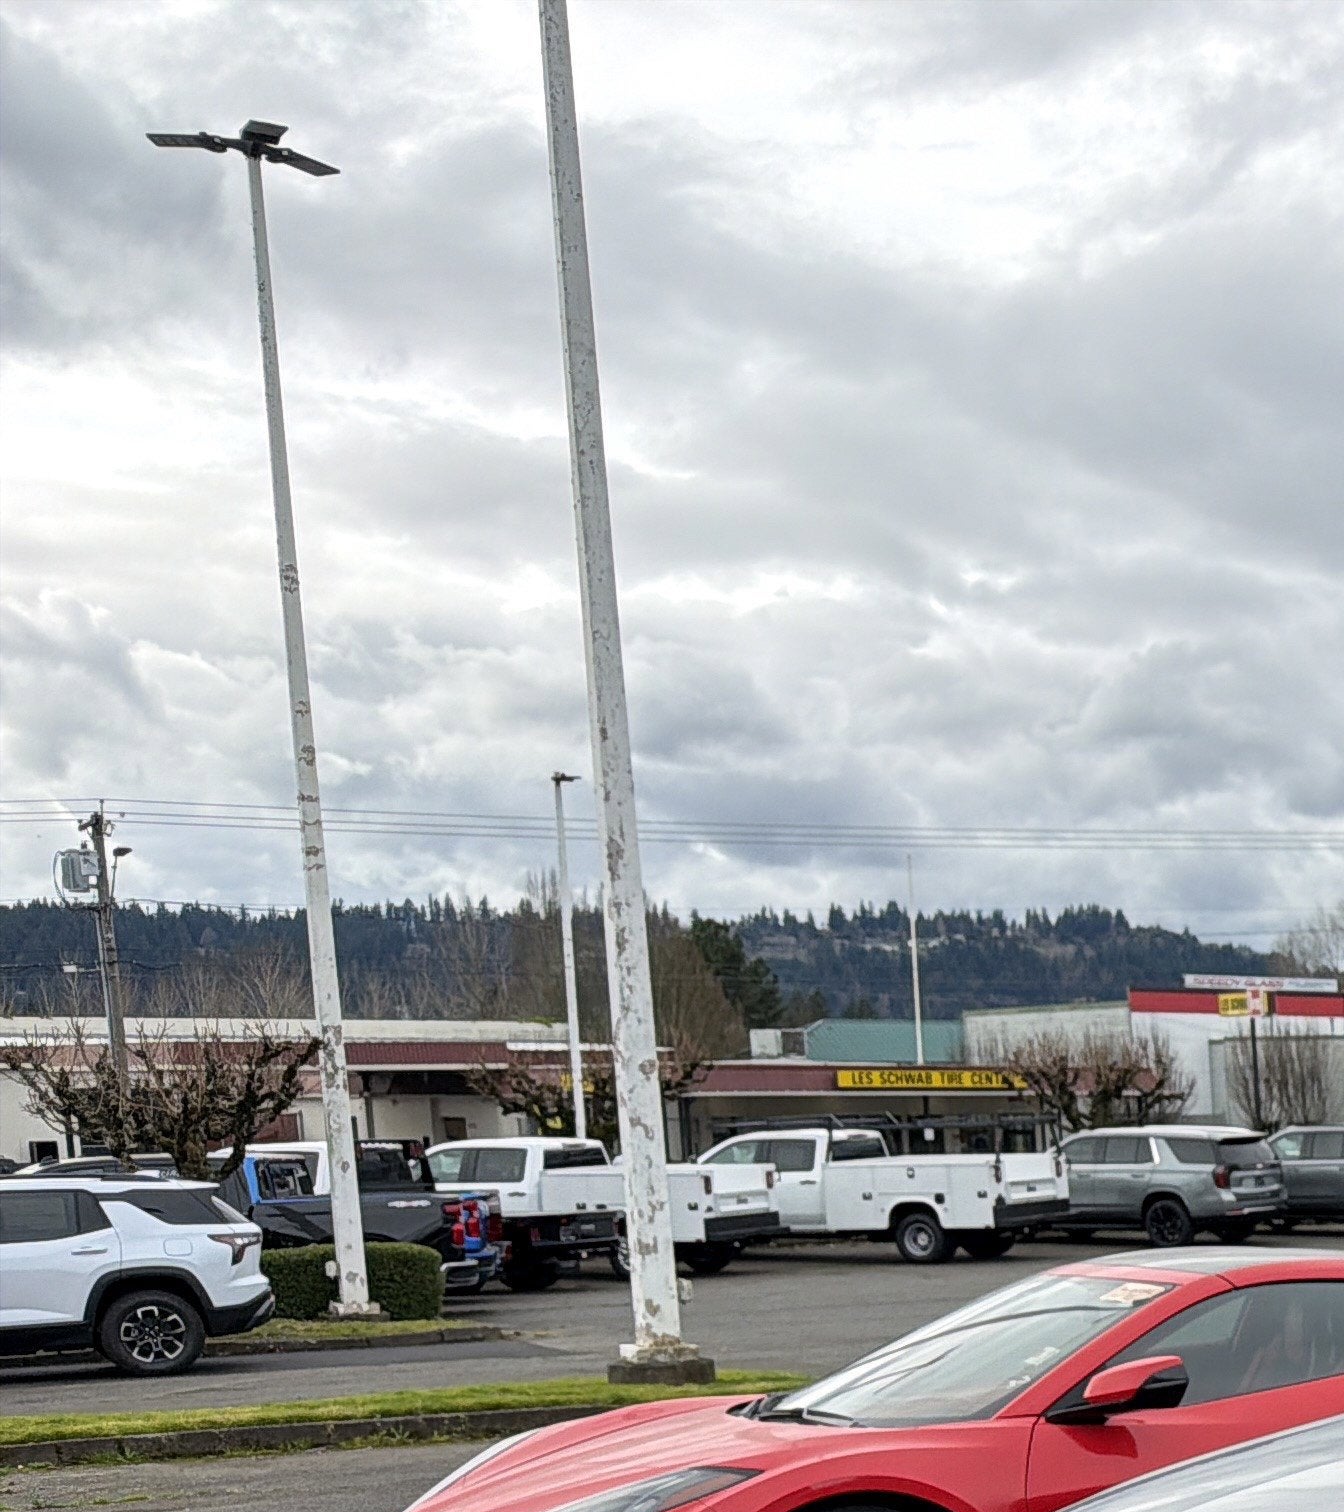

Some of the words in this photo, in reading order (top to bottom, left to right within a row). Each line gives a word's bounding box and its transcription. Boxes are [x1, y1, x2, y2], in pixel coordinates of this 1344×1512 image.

[851, 1072, 874, 1085] LES
[880, 1072, 933, 1085] SCHWAB
[940, 1072, 963, 1085] TIRE
